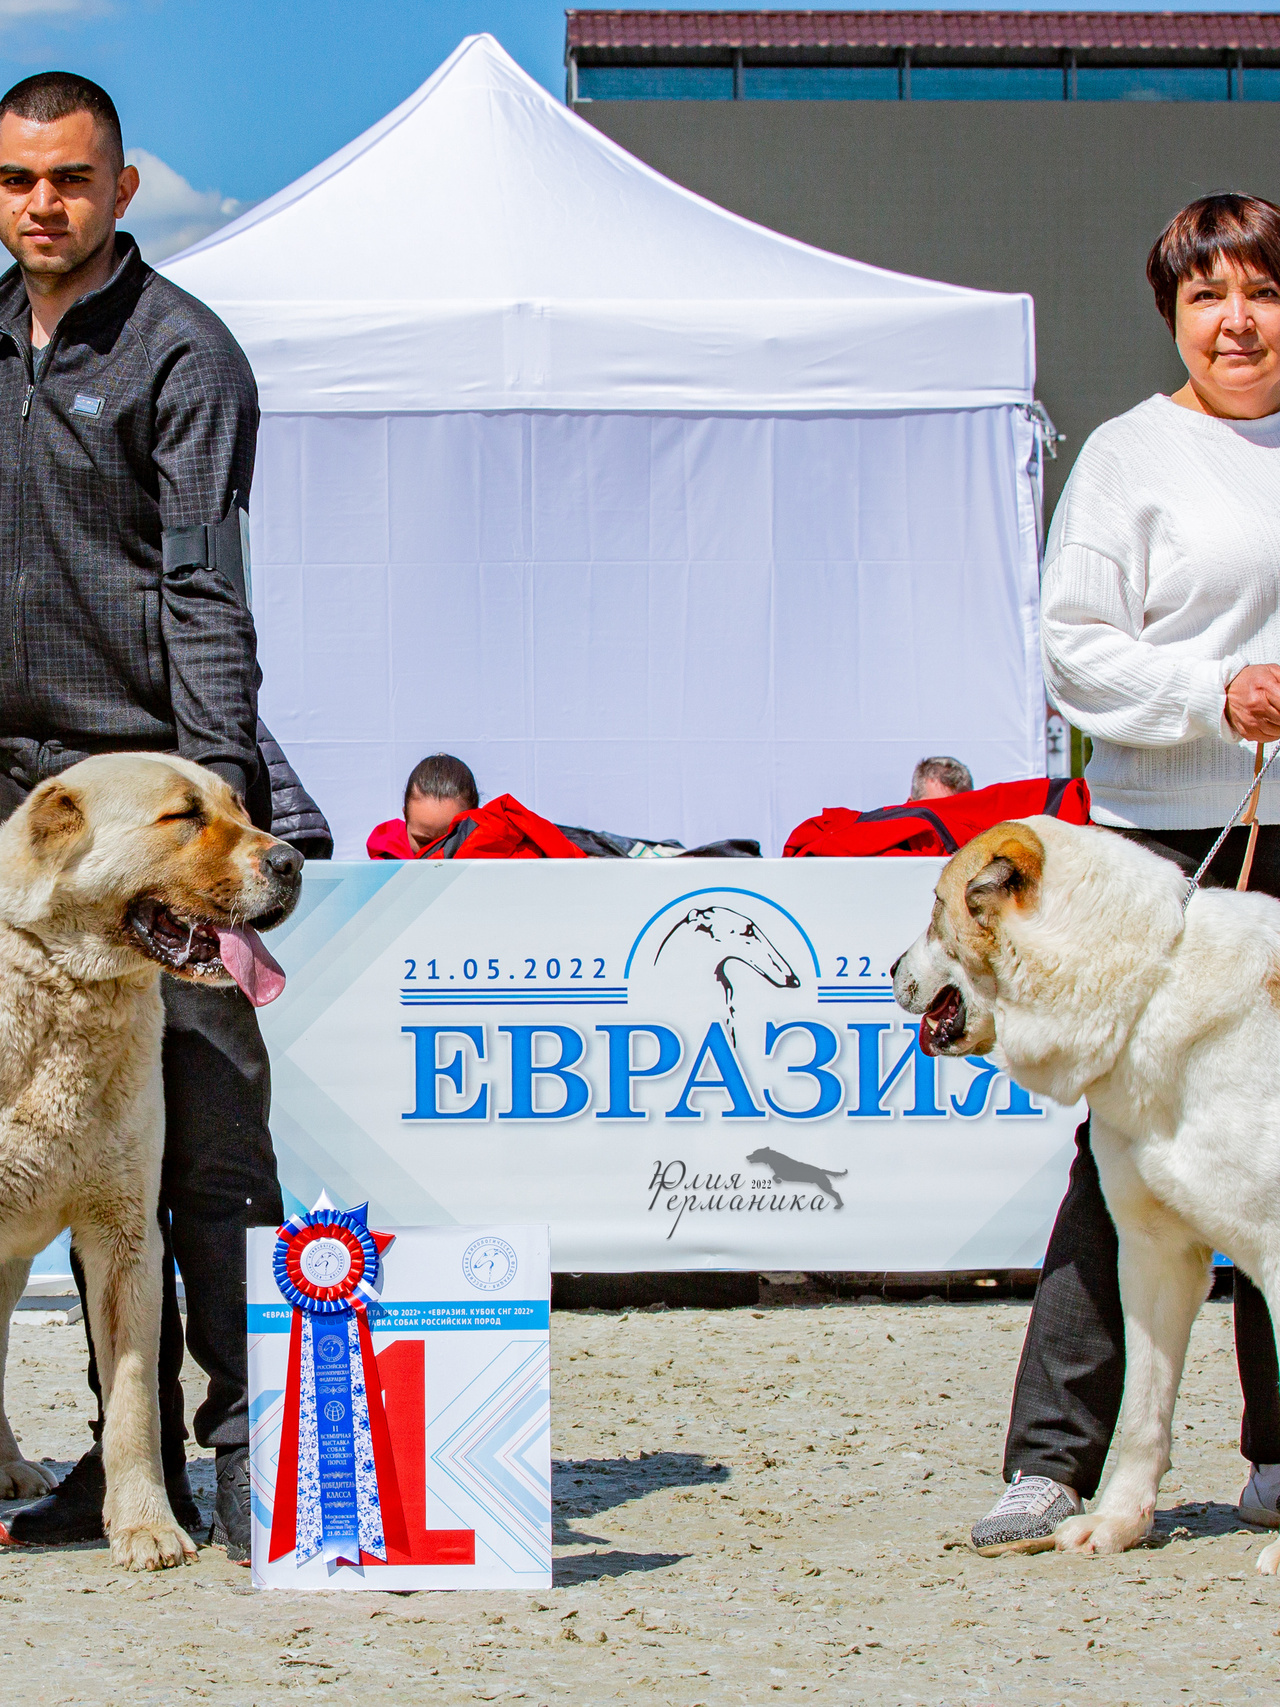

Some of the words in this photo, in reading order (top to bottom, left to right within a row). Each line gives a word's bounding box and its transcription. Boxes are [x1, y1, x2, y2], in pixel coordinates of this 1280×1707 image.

[404, 958, 606, 980] 21.05.2022
[836, 956, 886, 978] 22.
[401, 1309, 421, 1317] 2022»
[428, 1308, 468, 1316] «ЕВРАЗИЯ.
[470, 1308, 495, 1316] КУБОК
[497, 1308, 512, 1316] СНГ
[513, 1307, 534, 1315] 2022»
[393, 1318, 419, 1327] СОБАК
[421, 1317, 472, 1326] РОССИЙСКИХ
[474, 1317, 502, 1326] ПОРОД
